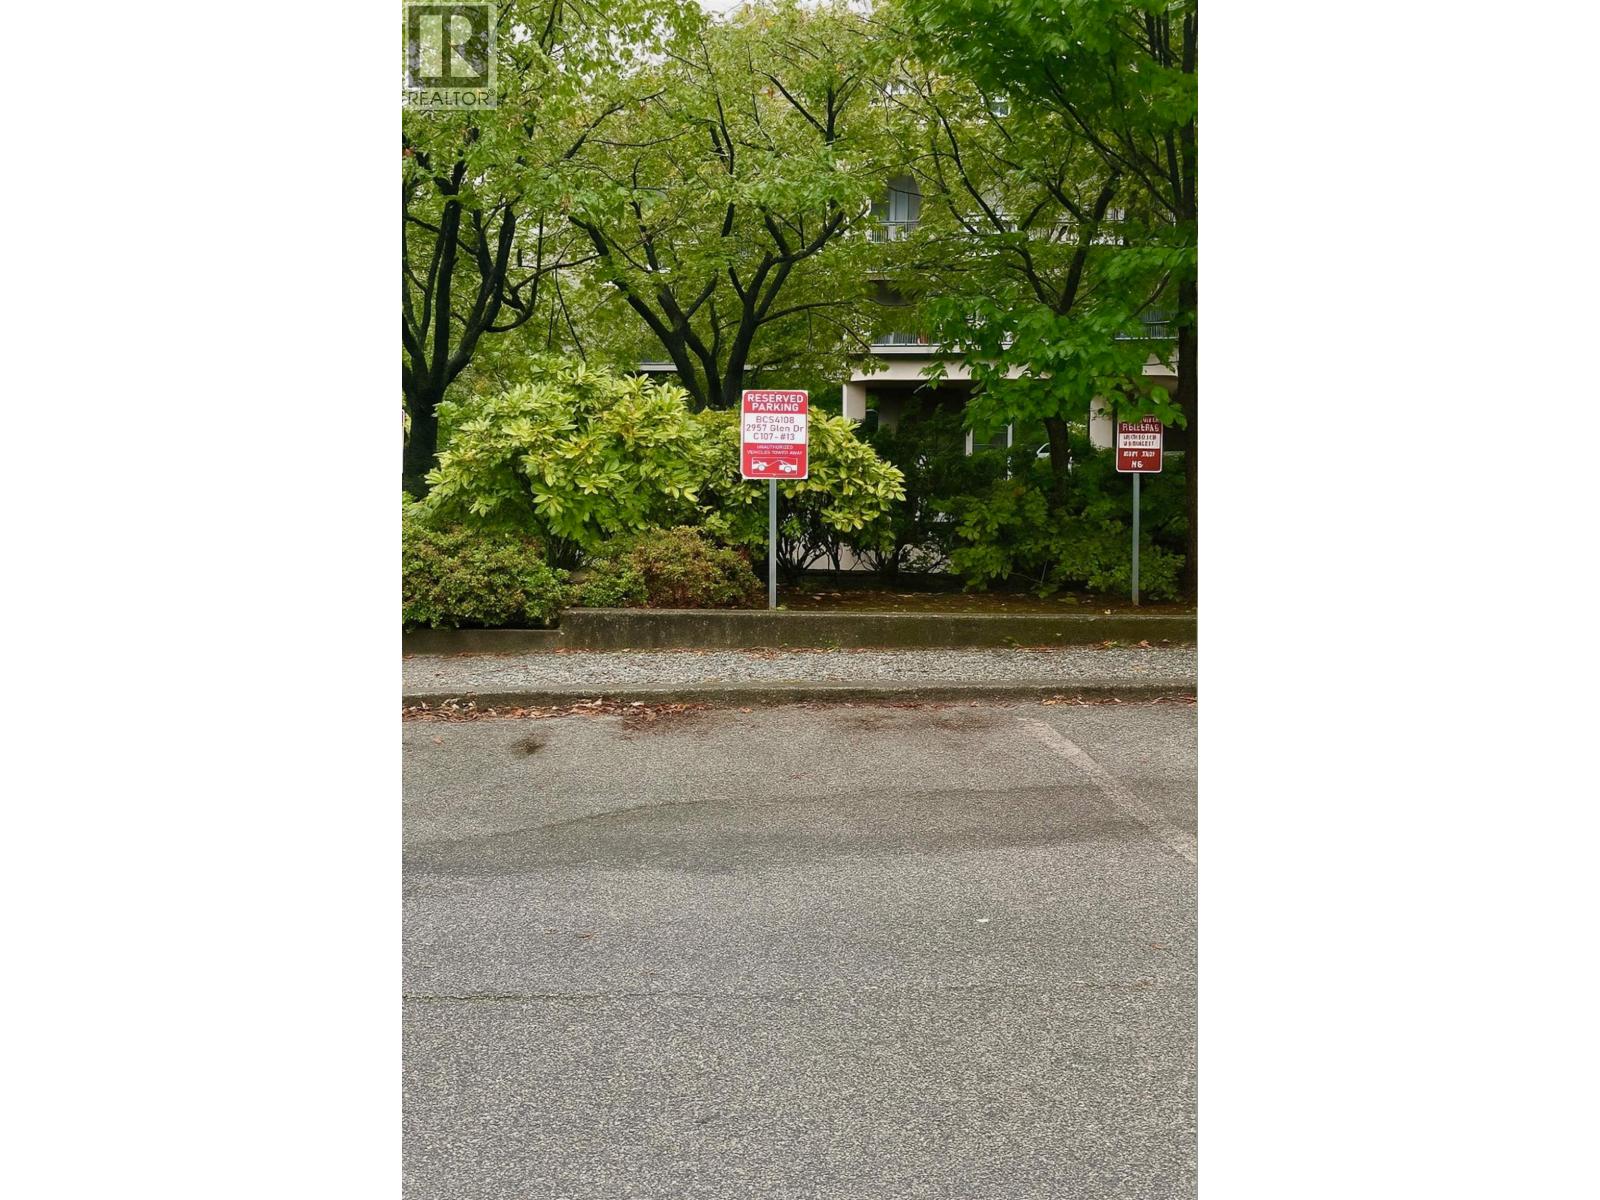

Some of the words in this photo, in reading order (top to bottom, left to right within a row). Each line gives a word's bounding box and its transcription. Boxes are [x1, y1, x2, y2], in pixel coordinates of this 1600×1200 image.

[747, 393, 804, 403] RESERVED
[751, 402, 799, 412] PARKING
[746, 423, 767, 432] 2957
[770, 424, 790, 432] Glen
[793, 424, 804, 433] Dr
